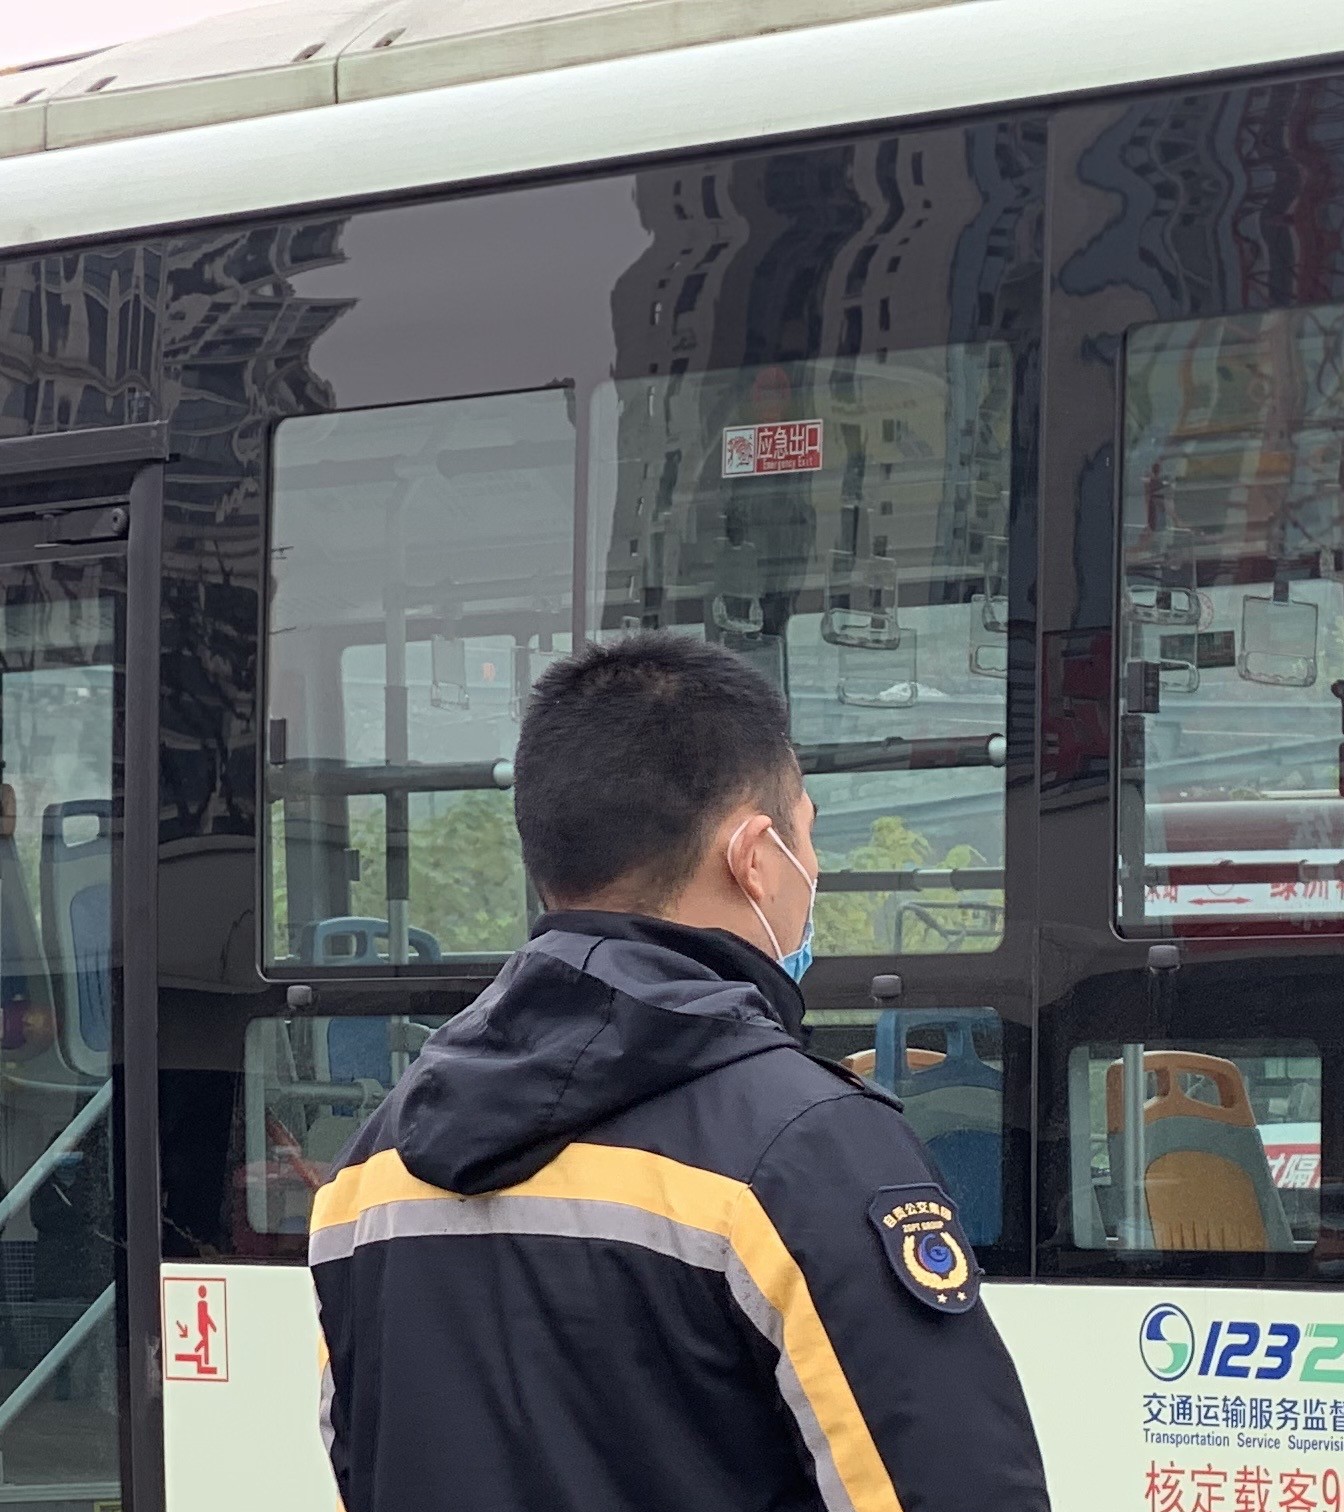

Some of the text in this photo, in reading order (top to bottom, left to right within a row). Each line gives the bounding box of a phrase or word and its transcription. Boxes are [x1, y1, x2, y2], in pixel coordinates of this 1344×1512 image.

[758, 424, 821, 460] 应急出口
[1143, 1428, 1230, 1449] Transportation
[1237, 1432, 1281, 1451] Service
